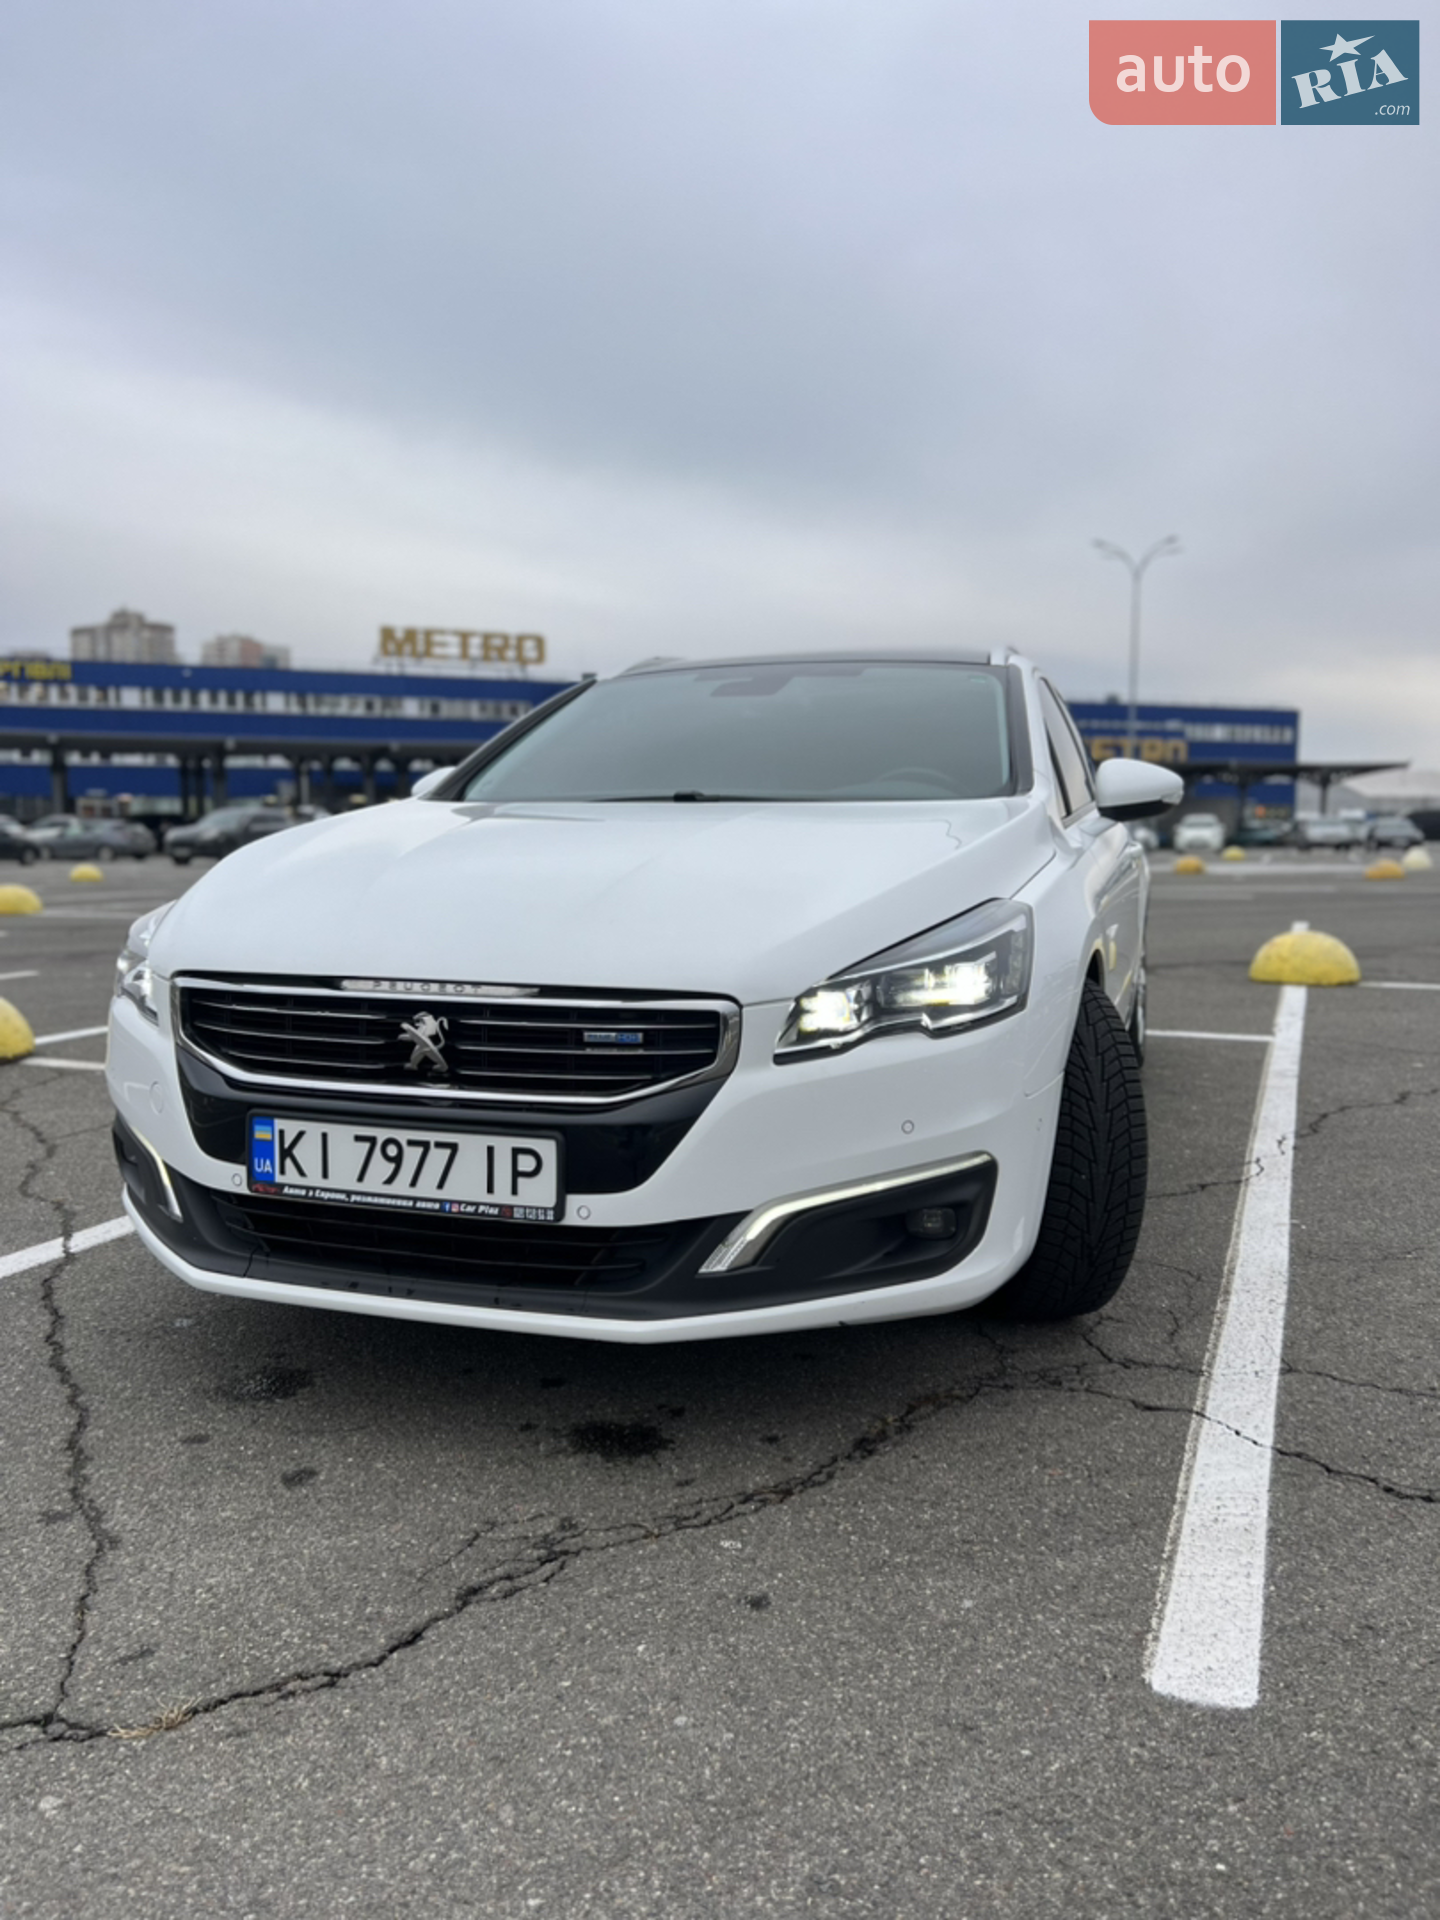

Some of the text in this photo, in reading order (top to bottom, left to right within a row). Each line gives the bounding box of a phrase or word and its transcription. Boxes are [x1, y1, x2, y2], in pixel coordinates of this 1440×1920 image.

[380, 625, 545, 665] METRO
[1084, 736, 1188, 762] ETRO
[372, 980, 483, 995] PEUGEOT
[254, 1158, 273, 1174] UA
[278, 1129, 544, 1197] KI 7977 IP
